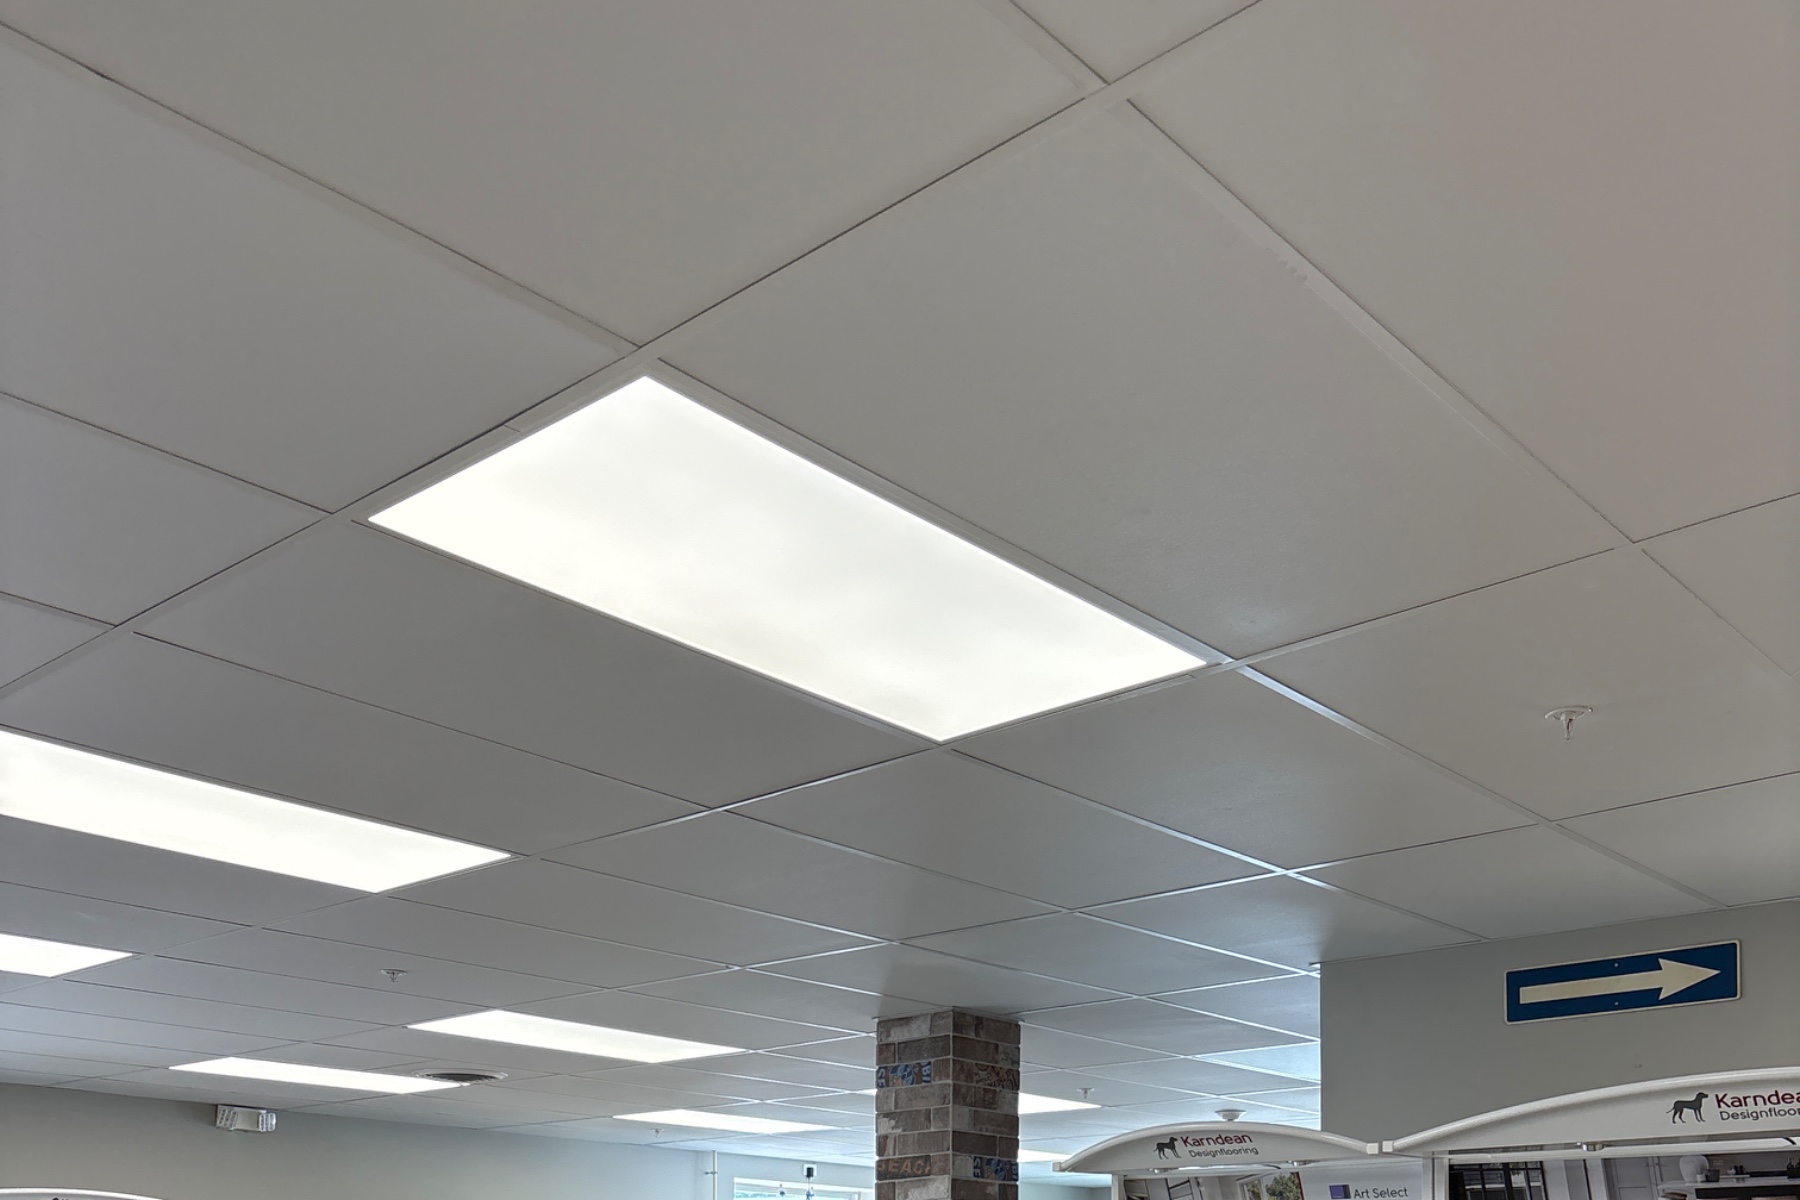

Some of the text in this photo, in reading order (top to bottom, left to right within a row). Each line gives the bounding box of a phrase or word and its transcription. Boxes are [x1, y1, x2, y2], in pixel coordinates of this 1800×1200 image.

[1180, 1134, 1253, 1147] Karndean
[1188, 1147, 1259, 1158] Designflooring
[1353, 1187, 1409, 1199] Art Select
